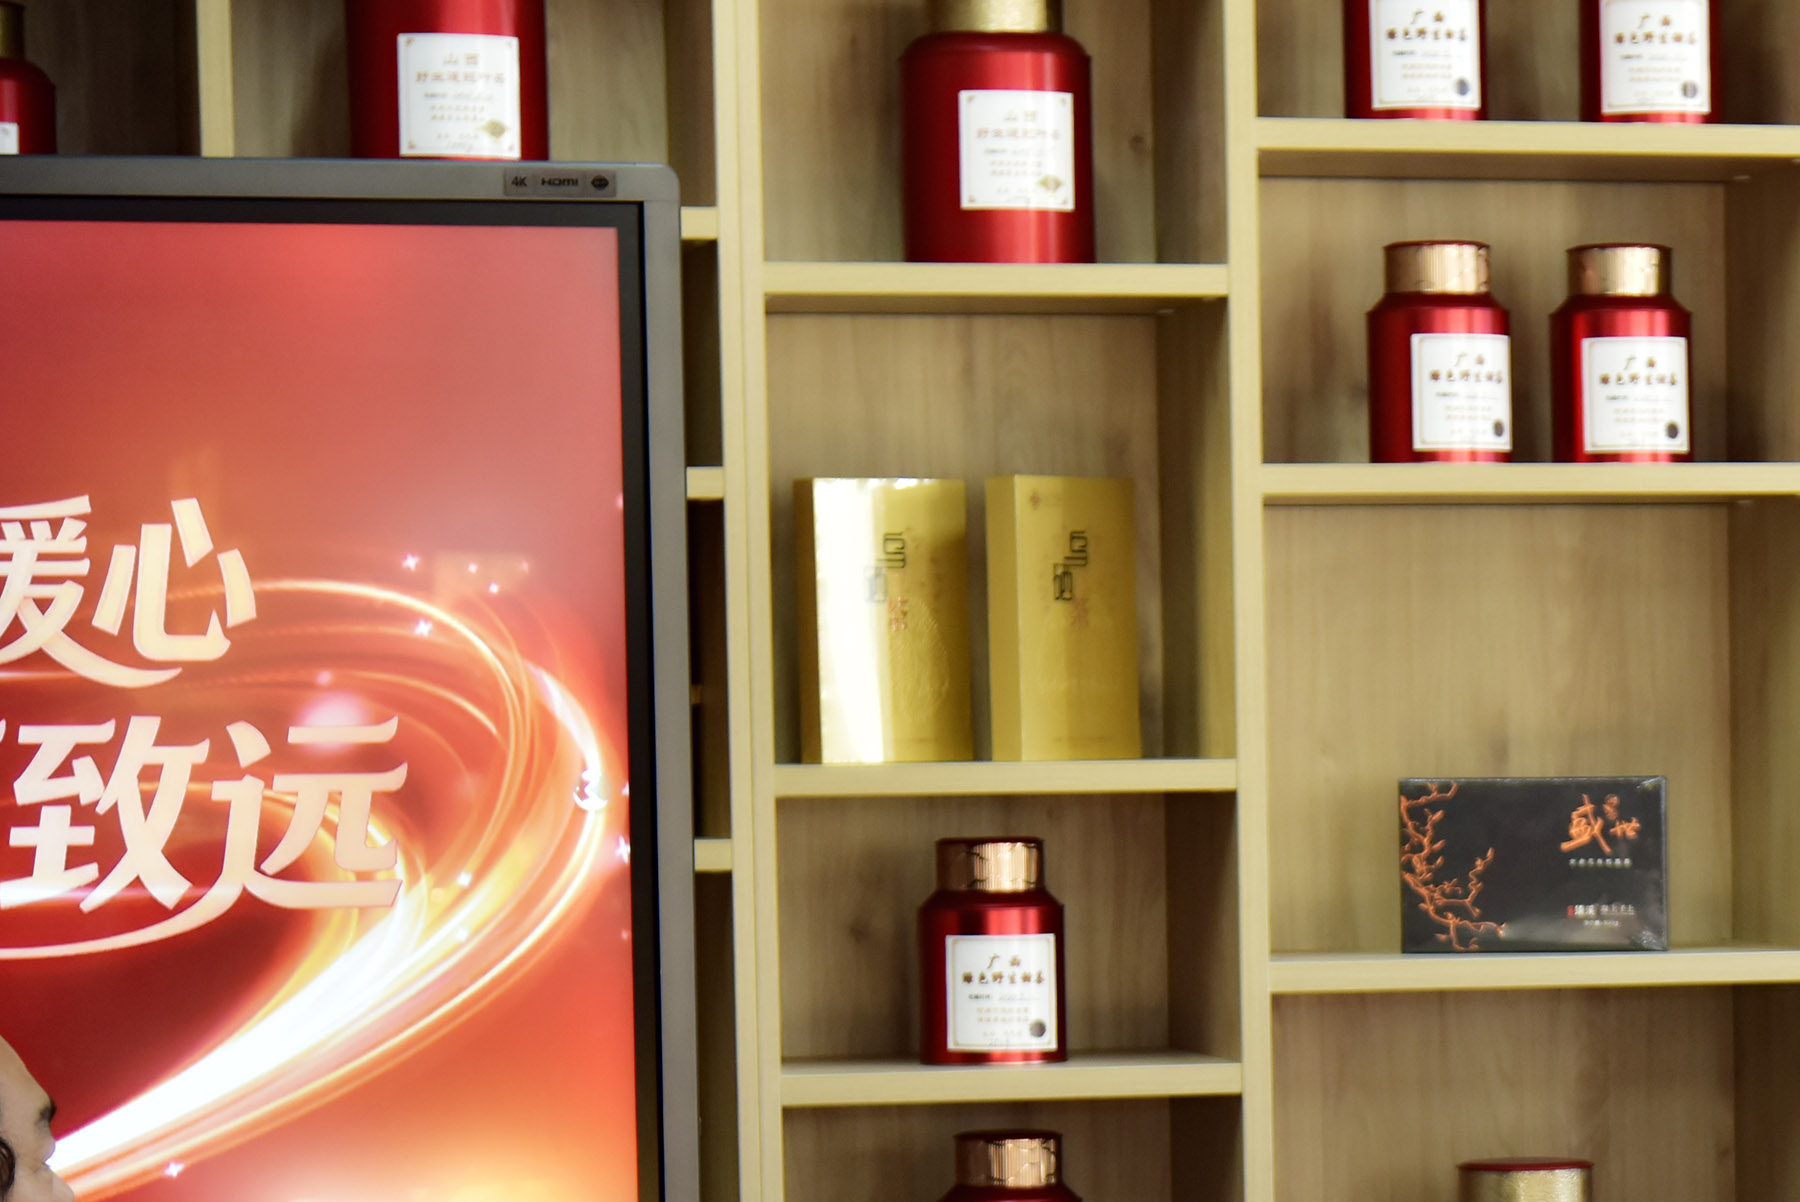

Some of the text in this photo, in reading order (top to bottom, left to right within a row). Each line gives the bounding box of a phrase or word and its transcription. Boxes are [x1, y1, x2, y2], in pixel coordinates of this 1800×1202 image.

[511, 175, 528, 187] 4K
[0, 495, 257, 687] 暖心
[0, 716, 408, 958] 致远
